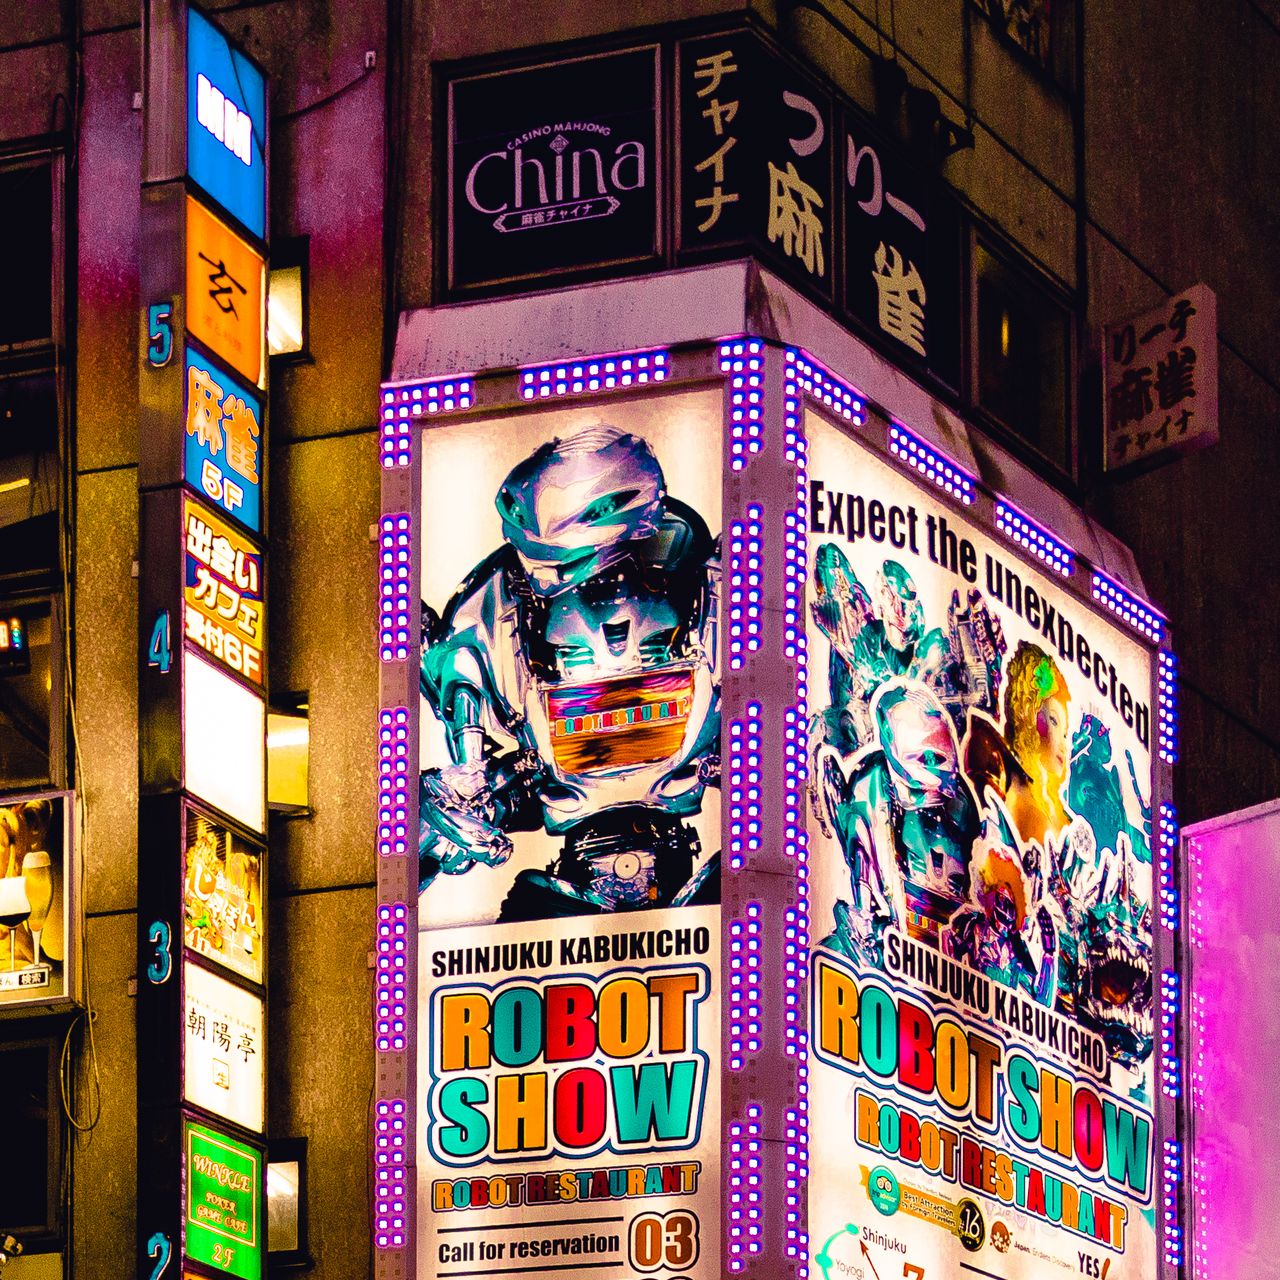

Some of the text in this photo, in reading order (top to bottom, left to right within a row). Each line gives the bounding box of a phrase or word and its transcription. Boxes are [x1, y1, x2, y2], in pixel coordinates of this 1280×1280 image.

[197, 73, 253, 166] MM
[507, 122, 611, 151] CASINO MAHJONG
[693, 49, 739, 233] チャイナ
[465, 141, 645, 215] China
[521, 202, 593, 226] 麻雀チャイナ
[148, 303, 173, 368] 5
[187, 366, 259, 484] 麻雀
[202, 459, 243, 511] 5F
[187, 516, 258, 592] 出会い
[195, 569, 258, 637] カフェ
[810, 480, 1150, 754] Expect the unexpected
[148, 608, 173, 674] 4
[186, 607, 261, 678] 受付6F
[147, 920, 172, 985] 3
[432, 927, 710, 977] SHINJUKU KABUKICHO
[187, 1007, 256, 1063] 朝陽亭
[440, 973, 699, 1072] ROBOT
[887, 938, 1105, 1073] SHINJUKU KABUKICHO
[820, 962, 1150, 1190] ROBOT SHOW
[439, 1062, 697, 1156] SHOW
[193, 1154, 251, 1193] WINKLE
[205, 1191, 237, 1216] POKER
[433, 1162, 700, 1211] ROBOT RESTAURANT
[857, 1095, 1127, 1251] ROBOT RESTAURANT
[211, 1243, 236, 1269] 2F
[439, 1233, 620, 1263] Call for reservation
[632, 1213, 699, 1270] 03
[862, 1227, 907, 1254] Shinjuku
